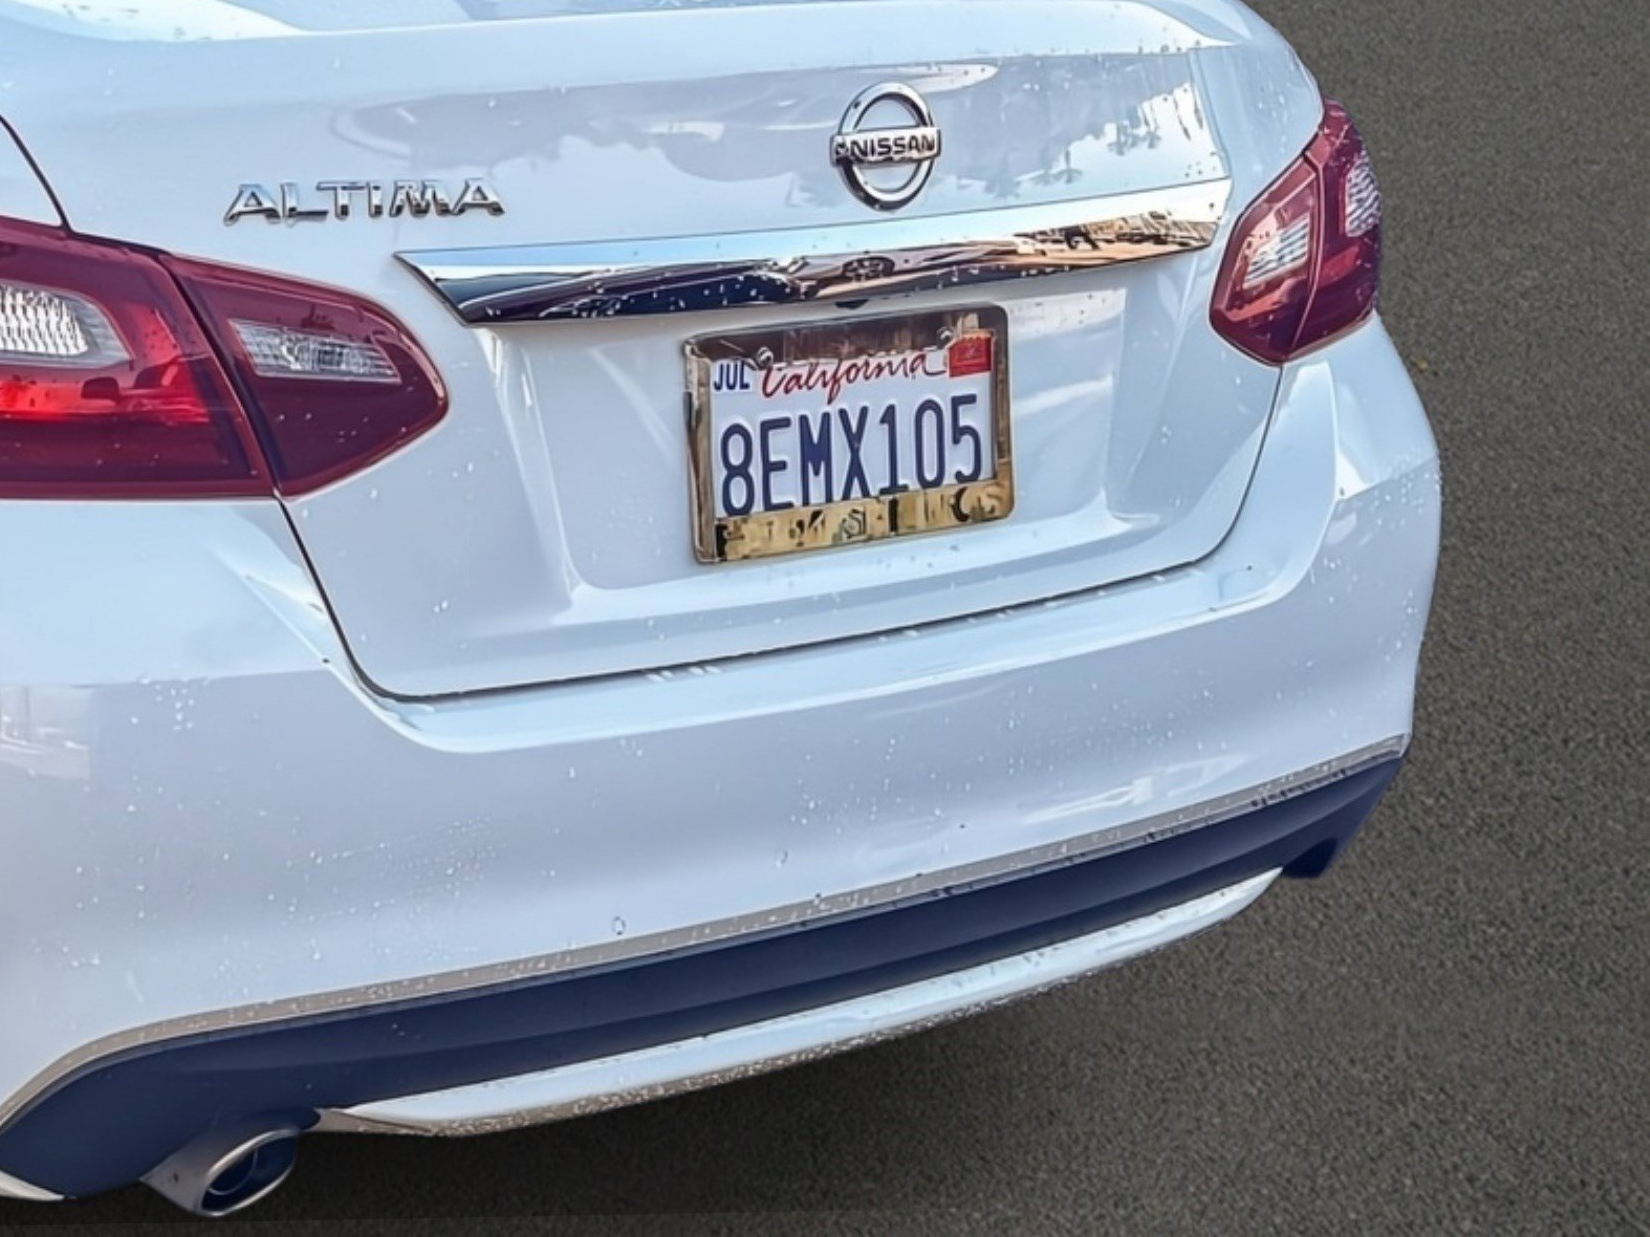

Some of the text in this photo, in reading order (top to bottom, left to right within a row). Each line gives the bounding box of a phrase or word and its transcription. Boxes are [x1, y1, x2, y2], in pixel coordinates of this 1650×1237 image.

[851, 135, 935, 157] NISSAN
[223, 178, 505, 227] ALTIMA
[713, 361, 750, 391] JUL
[761, 350, 947, 405] California
[719, 393, 983, 517] 8EMX105
